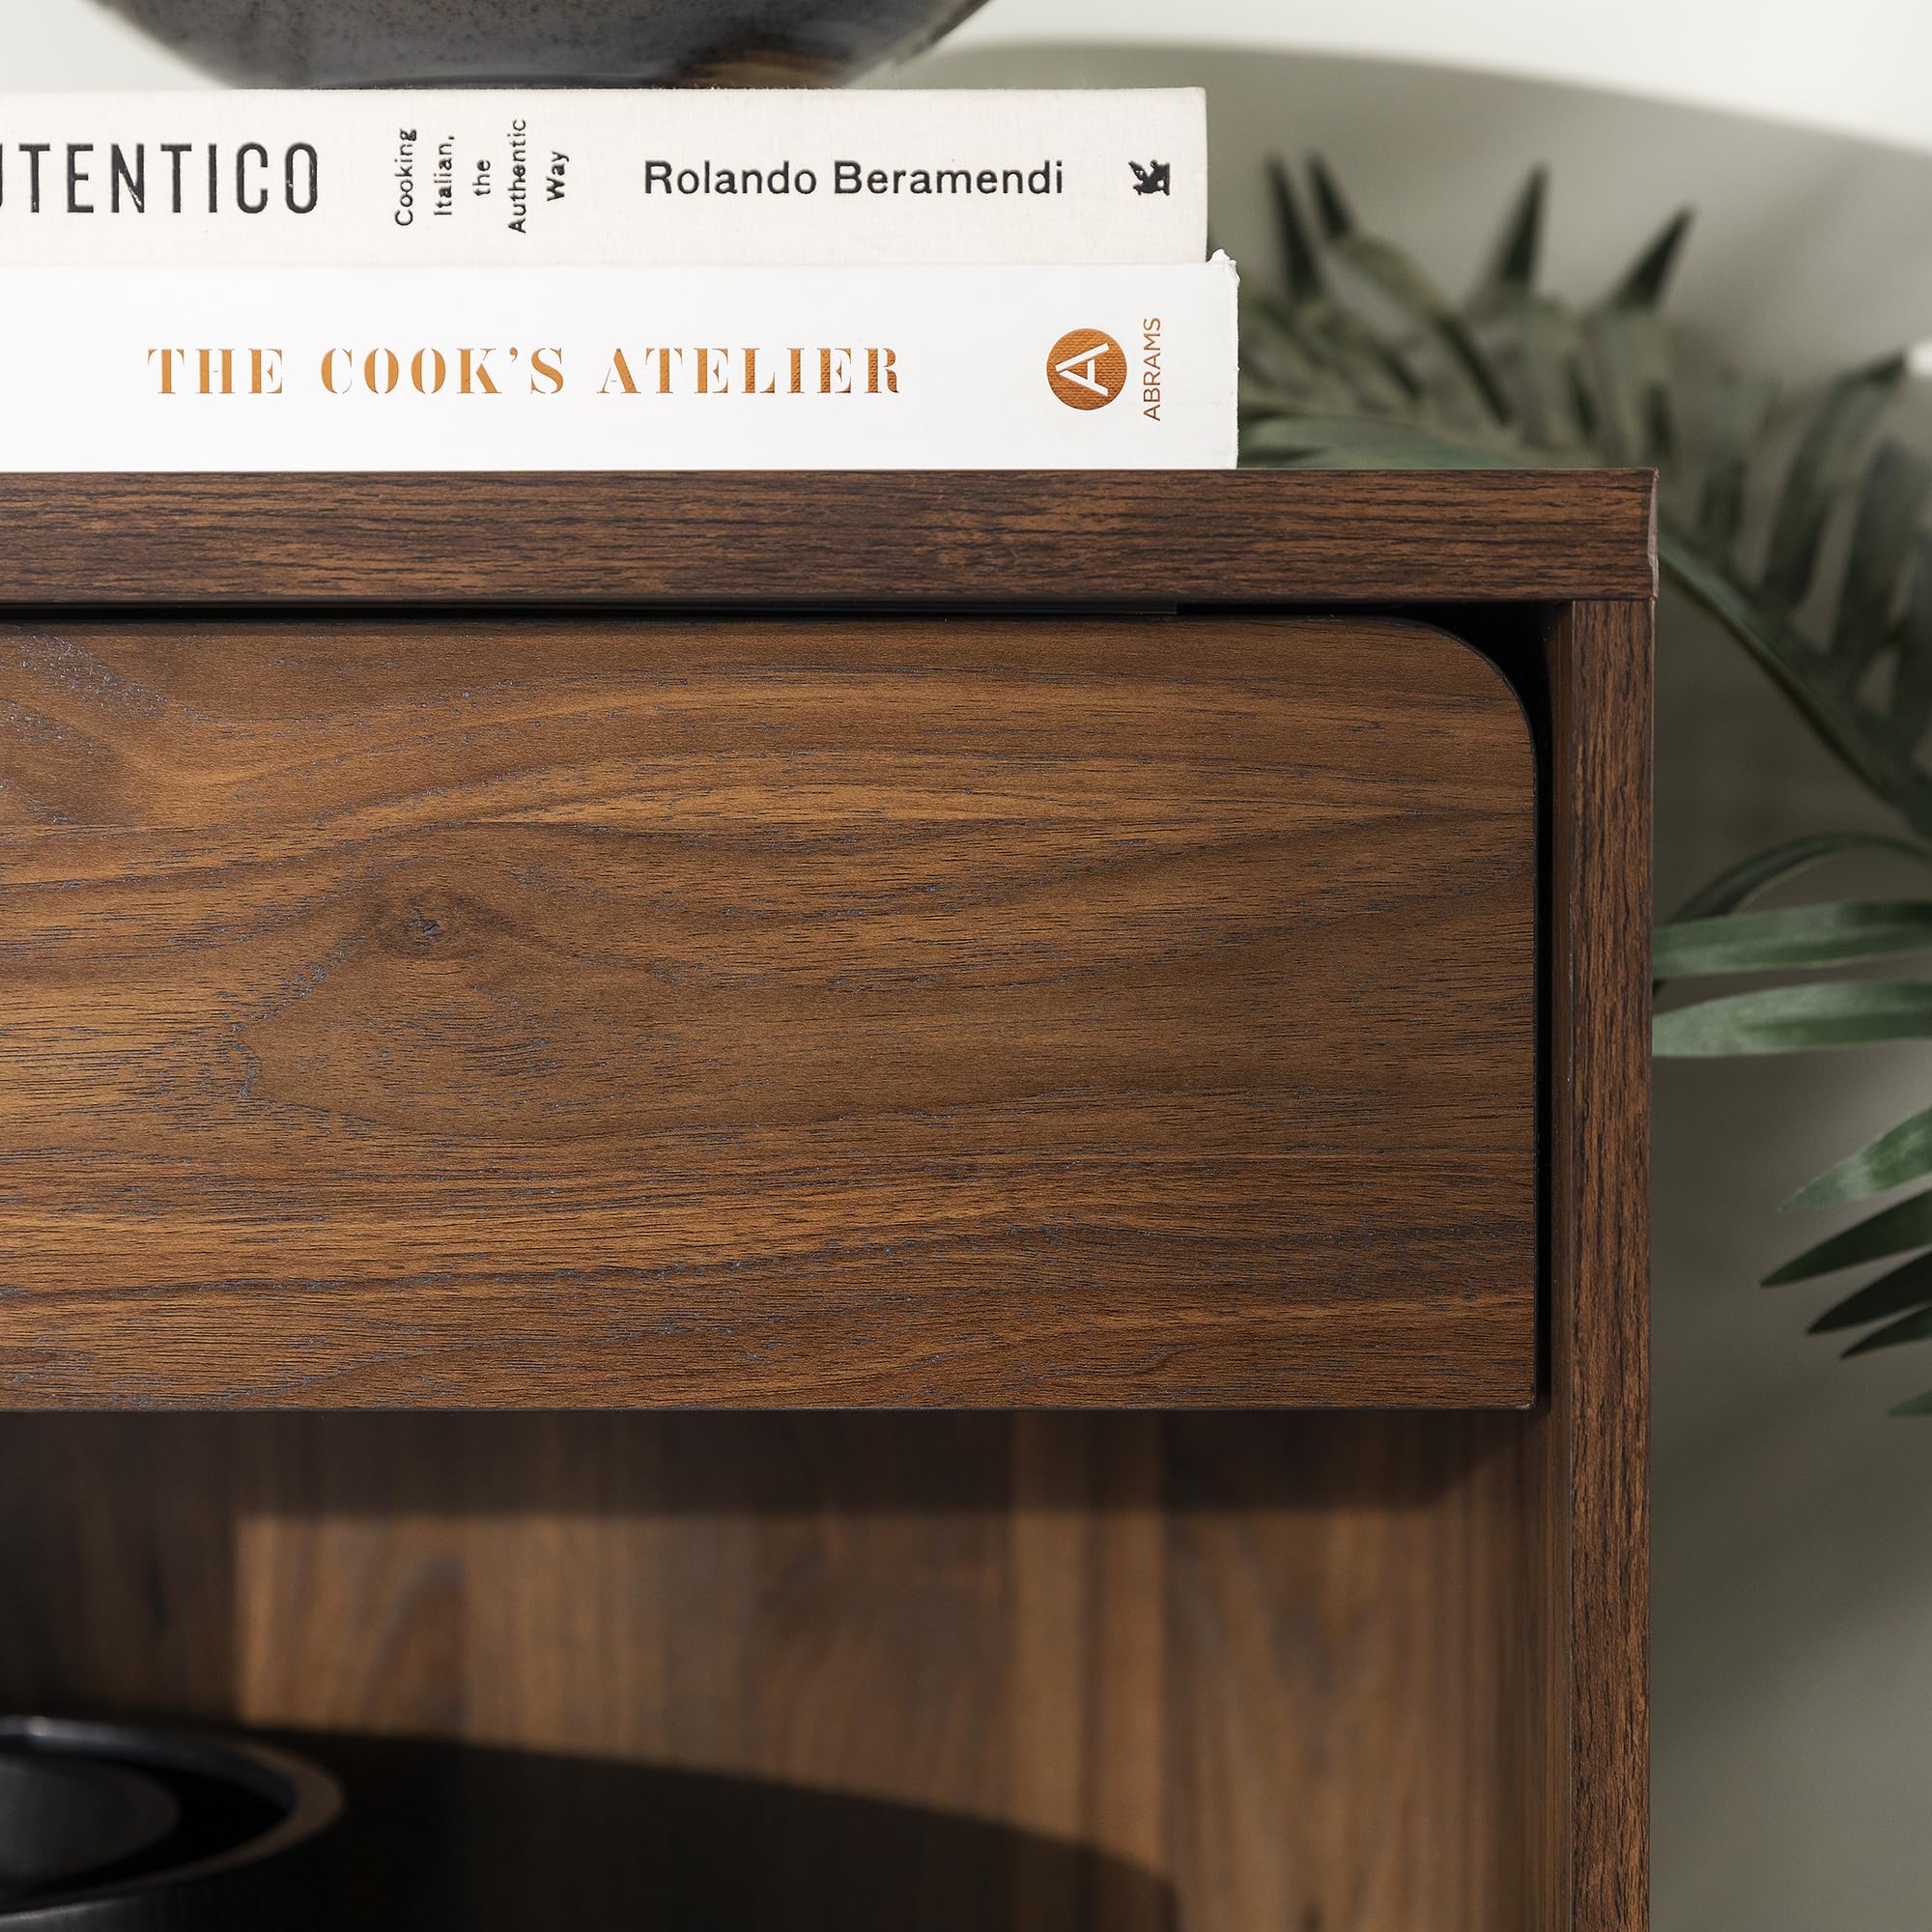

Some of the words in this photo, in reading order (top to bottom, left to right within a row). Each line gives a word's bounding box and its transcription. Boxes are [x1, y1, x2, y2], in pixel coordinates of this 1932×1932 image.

[0, 142, 318, 213] TENTICO
[394, 129, 416, 226] Cooking
[434, 136, 455, 215] Italian,
[472, 160, 491, 196] the
[507, 120, 526, 234] Authentic
[546, 152, 569, 201] Way
[645, 160, 816, 194] Rolando
[835, 160, 1062, 194] Beramendi
[148, 349, 282, 394] THE
[597, 348, 899, 393] ATELIER
[1144, 318, 1160, 421] ABRAMS
